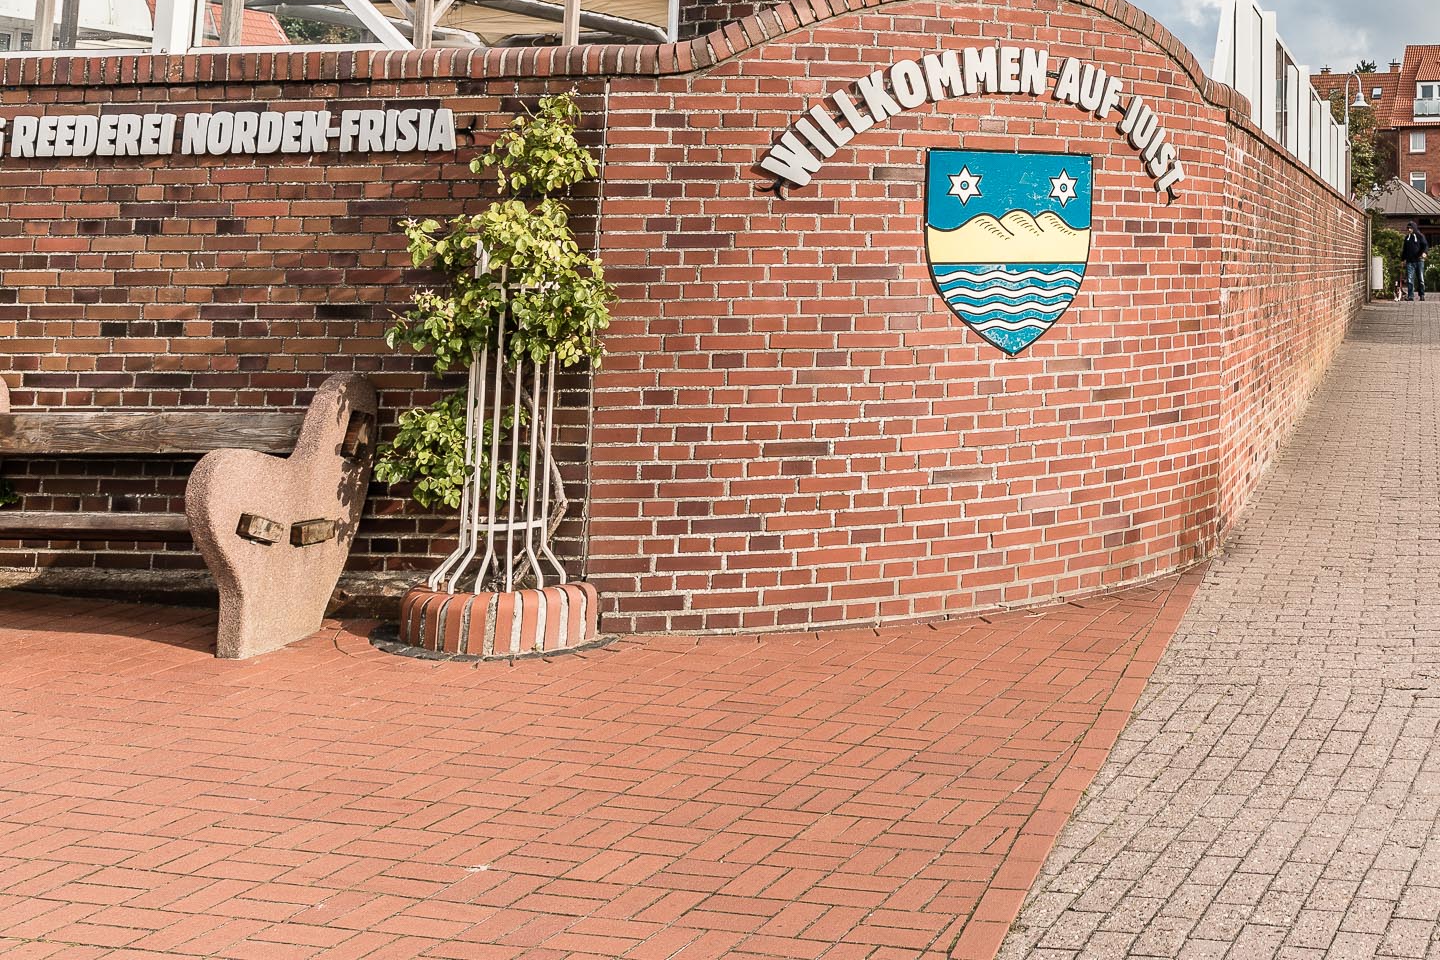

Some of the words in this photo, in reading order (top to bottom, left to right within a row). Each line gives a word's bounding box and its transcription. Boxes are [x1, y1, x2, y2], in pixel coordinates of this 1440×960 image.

[10, 113, 177, 158] REEDEREI
[181, 108, 457, 155] NORDEN-FRISIA
[760, 46, 1048, 186] WILLKOMMEN
[1054, 56, 1124, 119] AUF
[1117, 95, 1186, 192] JUIST
